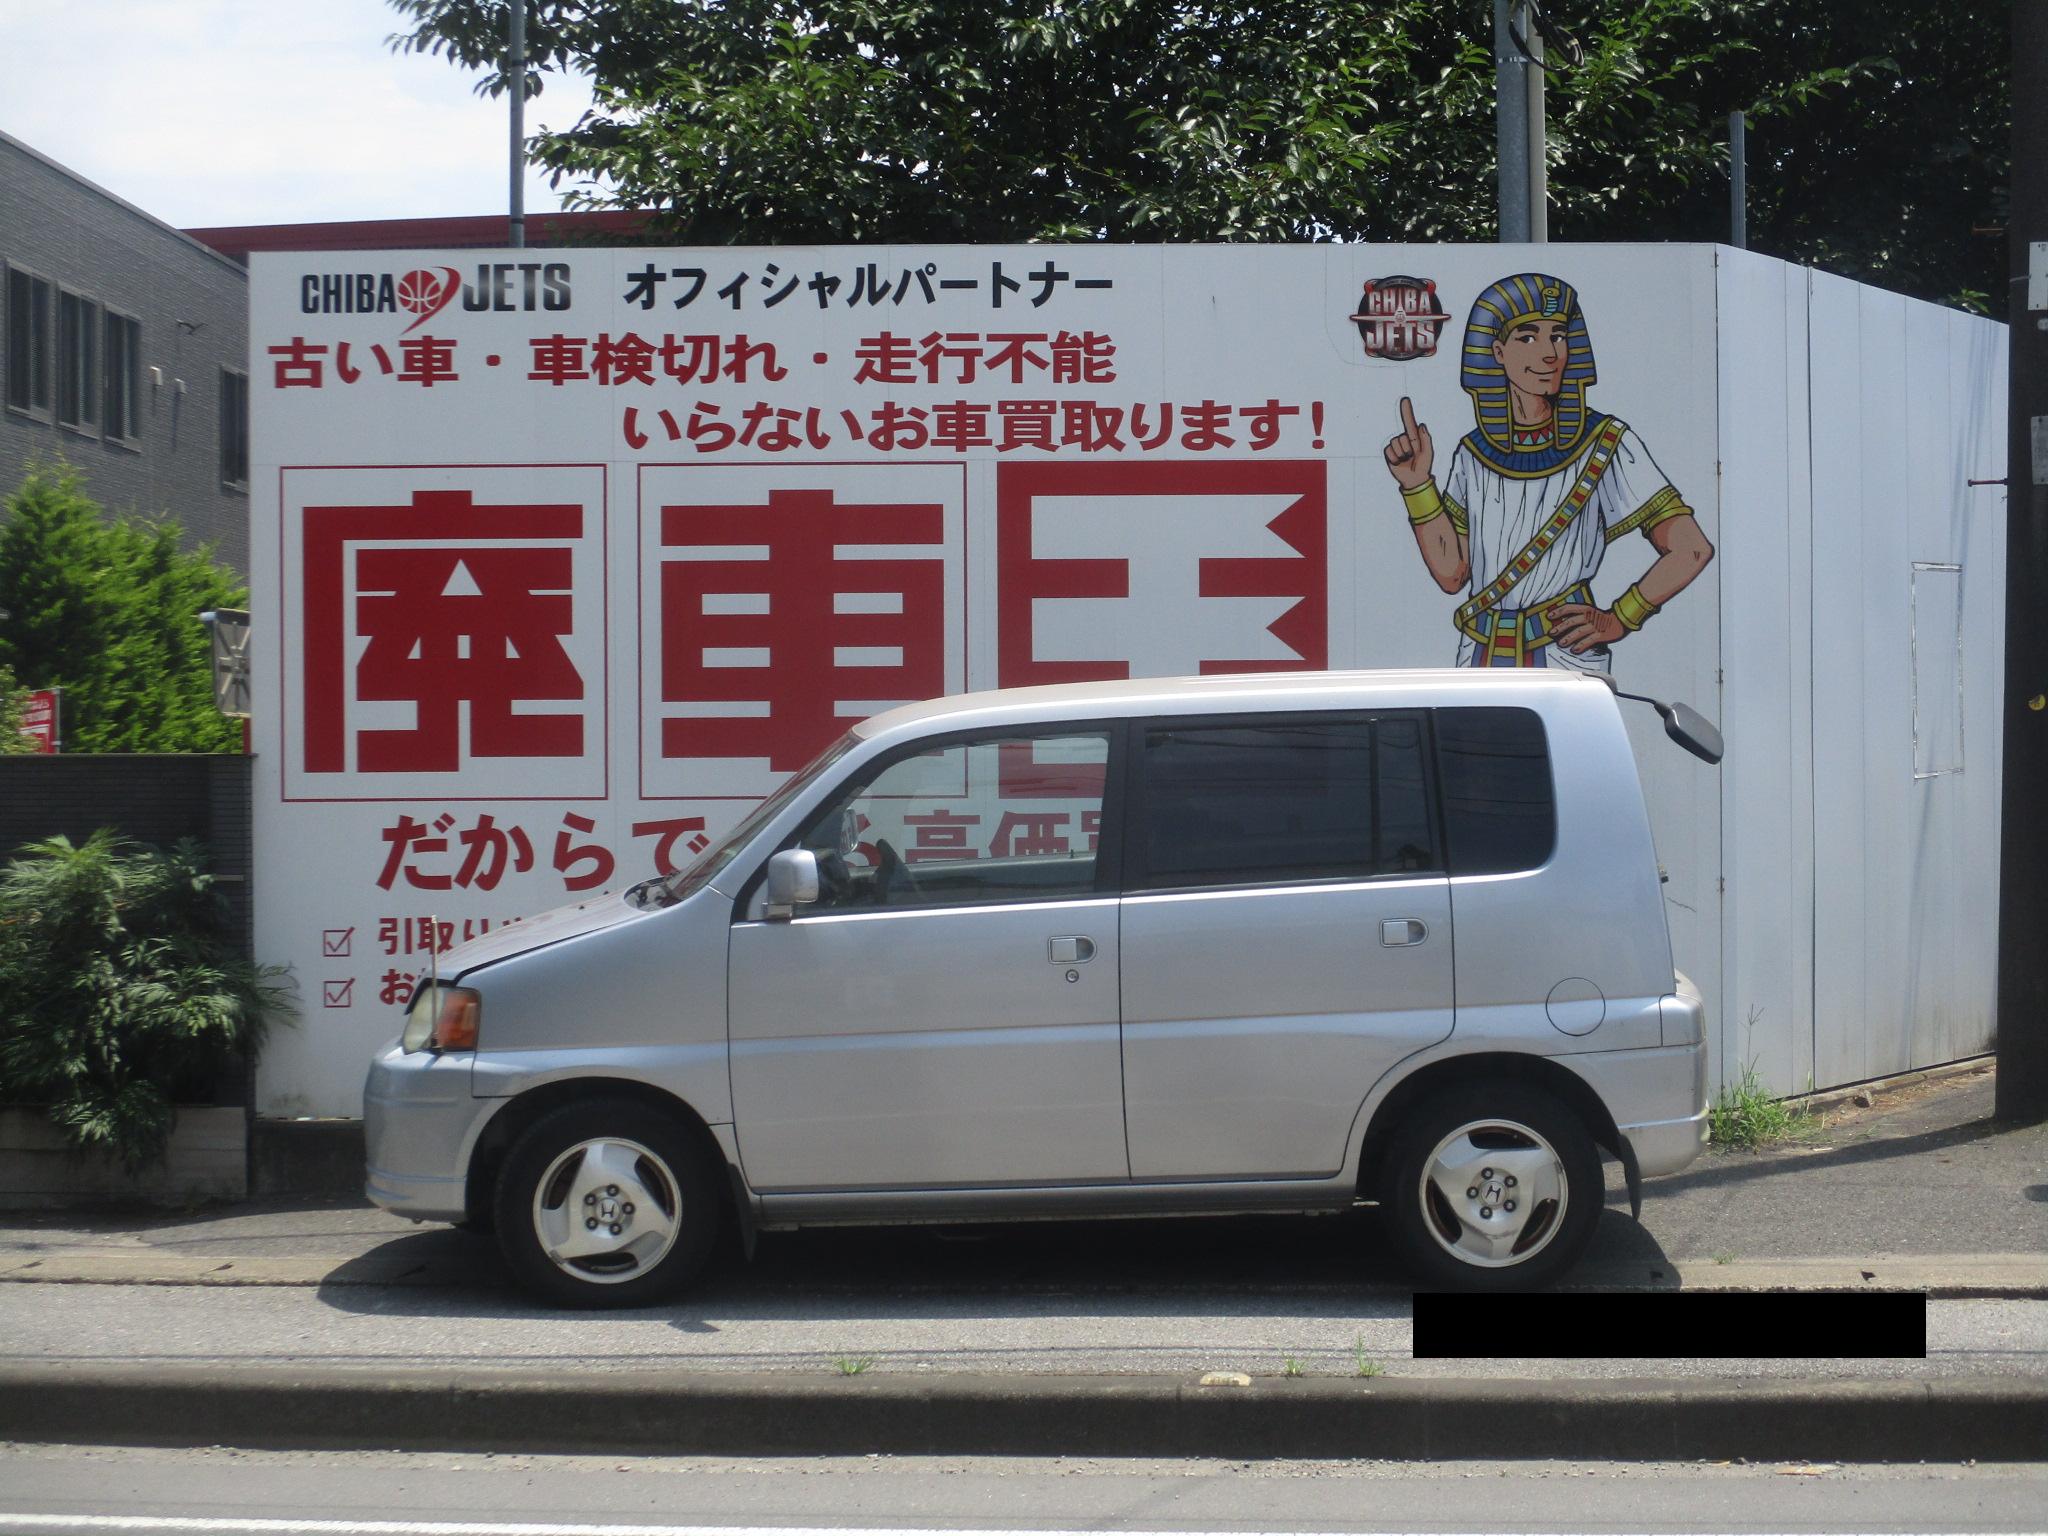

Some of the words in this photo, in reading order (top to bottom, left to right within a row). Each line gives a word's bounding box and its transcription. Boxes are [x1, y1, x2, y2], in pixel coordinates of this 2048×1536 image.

[301, 273, 397, 315] CHIBA
[462, 263, 571, 313] JETS
[623, 261, 1113, 310] オフィシャルパートナー
[267, 331, 1118, 389] 古い車・車検切れ・走行不能
[1366, 319, 1435, 353] JETS
[622, 399, 1326, 453] いらないお車買取ります！
